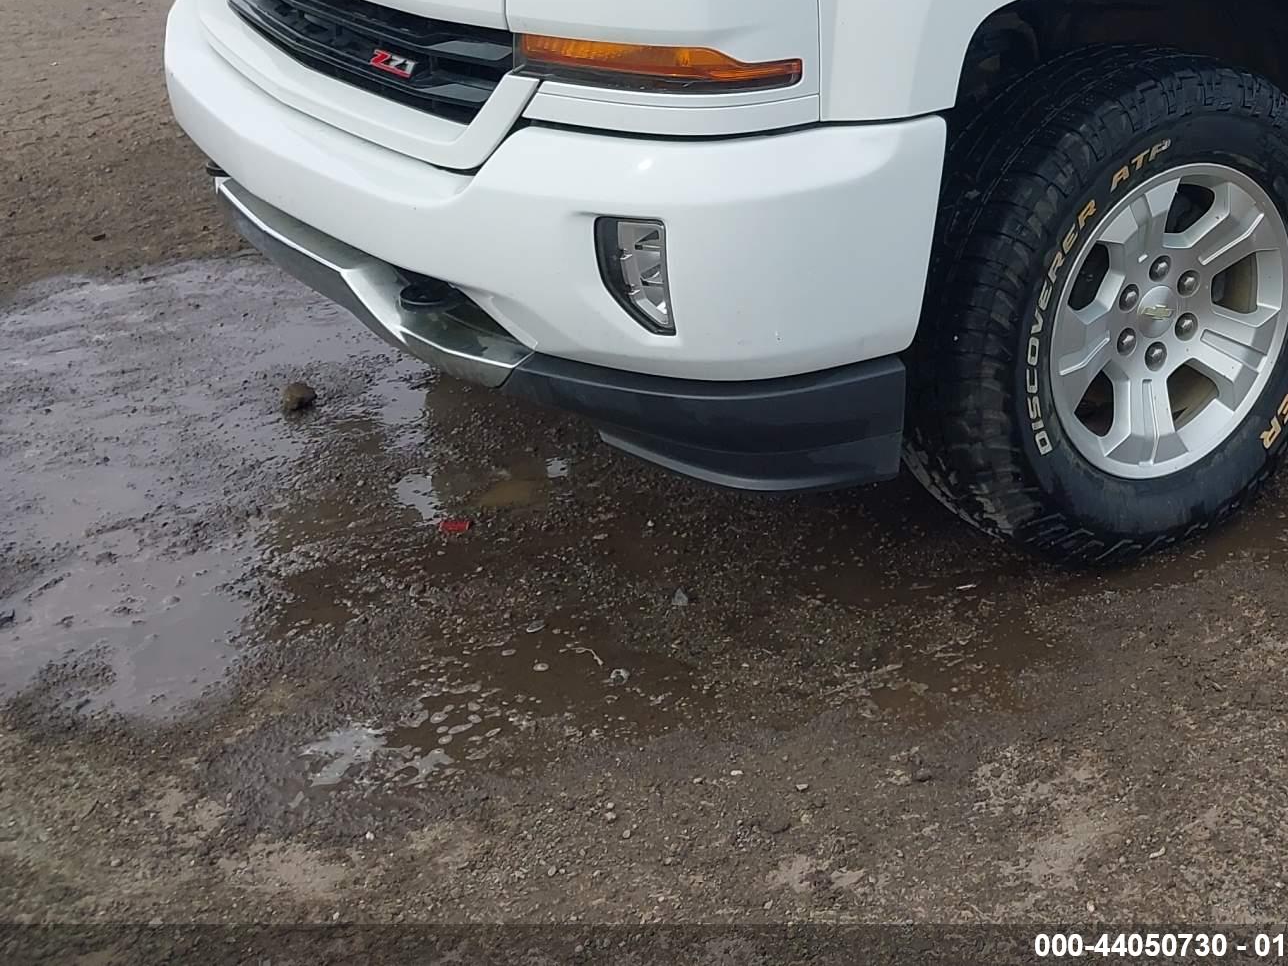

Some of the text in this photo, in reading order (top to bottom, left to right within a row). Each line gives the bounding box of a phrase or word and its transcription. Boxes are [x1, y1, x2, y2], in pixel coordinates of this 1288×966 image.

[369, 49, 416, 79] Z71
[1026, 138, 1172, 456] DISCOVERER ATP
